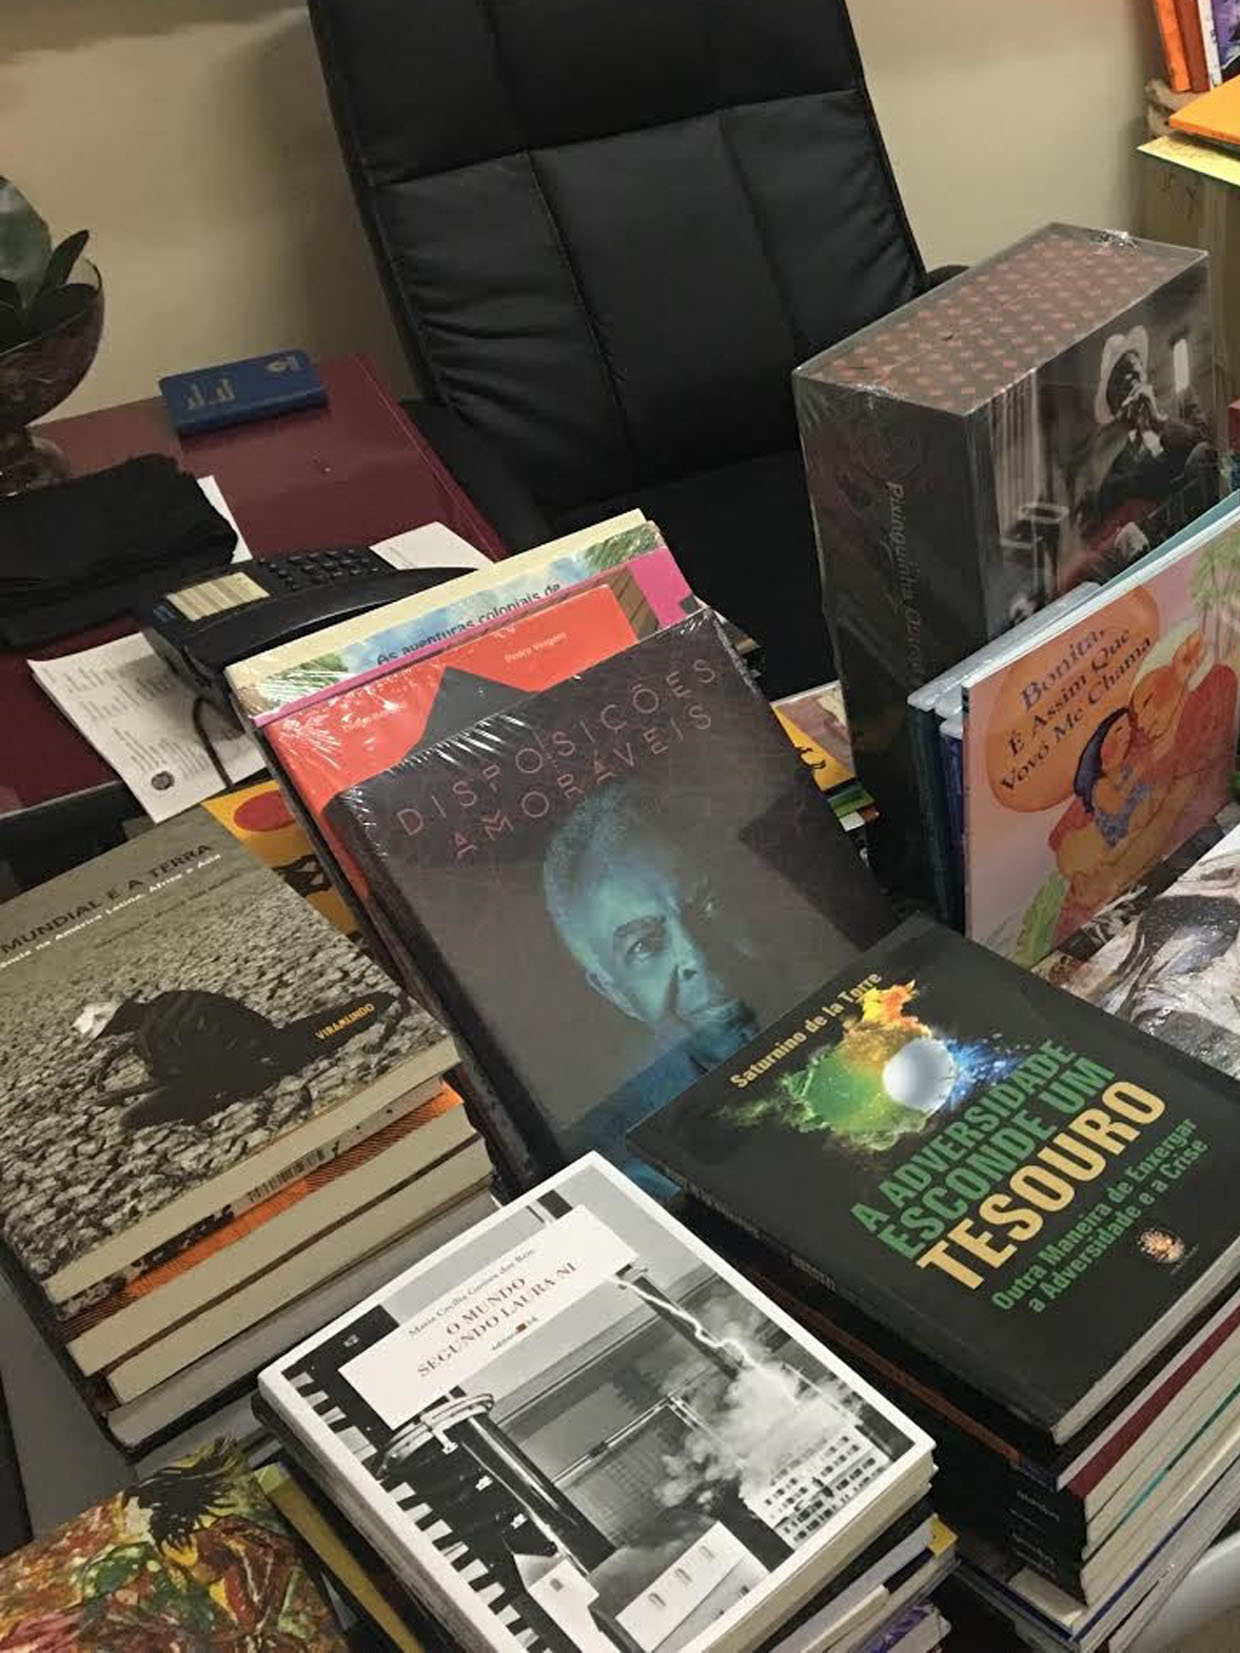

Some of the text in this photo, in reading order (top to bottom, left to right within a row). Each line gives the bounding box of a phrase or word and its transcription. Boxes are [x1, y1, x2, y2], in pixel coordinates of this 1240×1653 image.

[1030, 678, 1088, 741] Assim
[1090, 628, 1131, 672] Que
[1053, 708, 1085, 744] Me
[1087, 636, 1152, 706] Chama
[397, 658, 716, 837] DISPOSIÇÕES
[453, 704, 712, 860] AMORÁVEIS
[0, 842, 214, 955] MUNDIAL E A TERRA
[314, 1003, 376, 1040] VIRAMUNDO
[730, 973, 882, 1089] Saturnino de la Torre
[850, 1202, 890, 1233] A
[878, 1039, 1077, 1209] ADVERSIDADE
[877, 1108, 1058, 1260] ESCONDE
[1039, 1056, 1116, 1115] UM
[916, 1080, 1167, 1291] TESOURO
[991, 1262, 1048, 1311] Outra
[1038, 1202, 1112, 1265] Maneira
[1107, 1179, 1134, 1204] de
[1126, 1118, 1199, 1184] Enxergar
[1028, 1138, 1209, 1313] a Adversidade e a Crise
[408, 1317, 436, 1337] Maria
[417, 1316, 500, 1378] SEGUNDO
[500, 1278, 556, 1319] LAURA
[446, 1277, 526, 1337] O MUNDO
